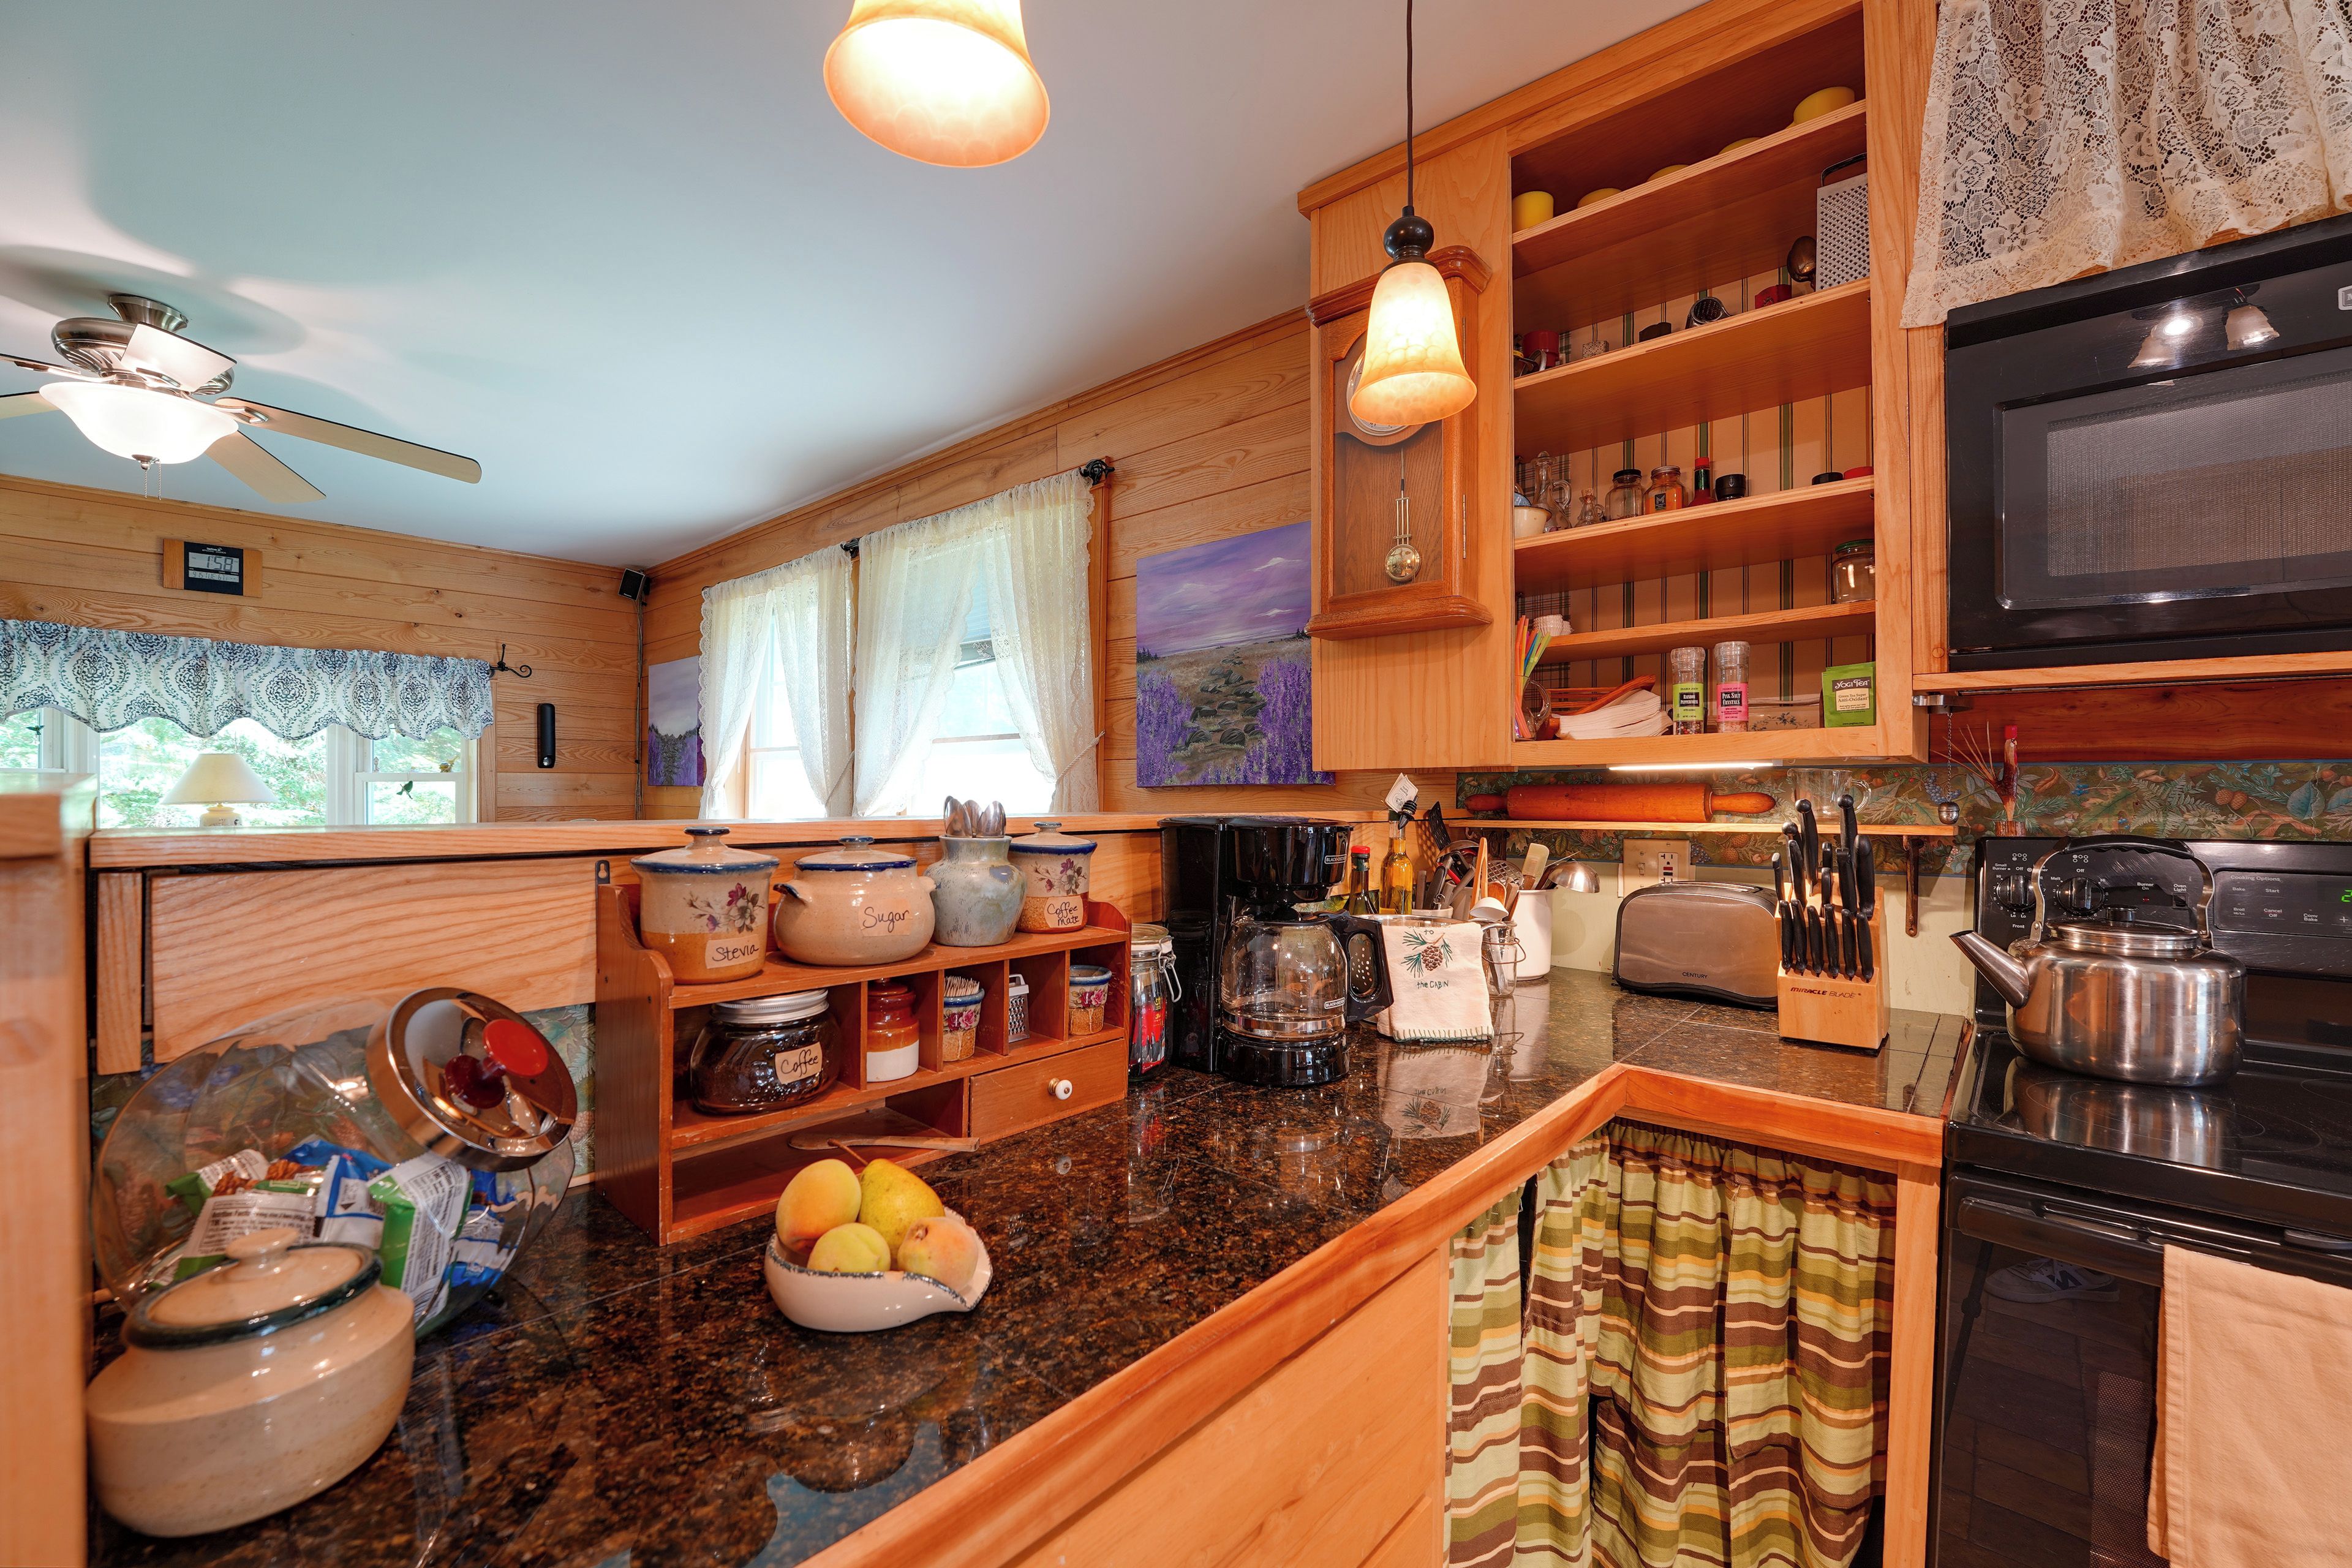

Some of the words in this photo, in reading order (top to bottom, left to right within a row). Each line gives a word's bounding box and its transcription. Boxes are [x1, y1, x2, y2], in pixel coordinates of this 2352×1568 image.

[1047, 902, 1078, 918] Coffee
[862, 907, 910, 933] Sugar
[712, 944, 760, 962] Stevia
[1430, 980, 1449, 989] CABIN
[1790, 987, 1827, 995] MIRACLE
[781, 1049, 818, 1077] Coffee
